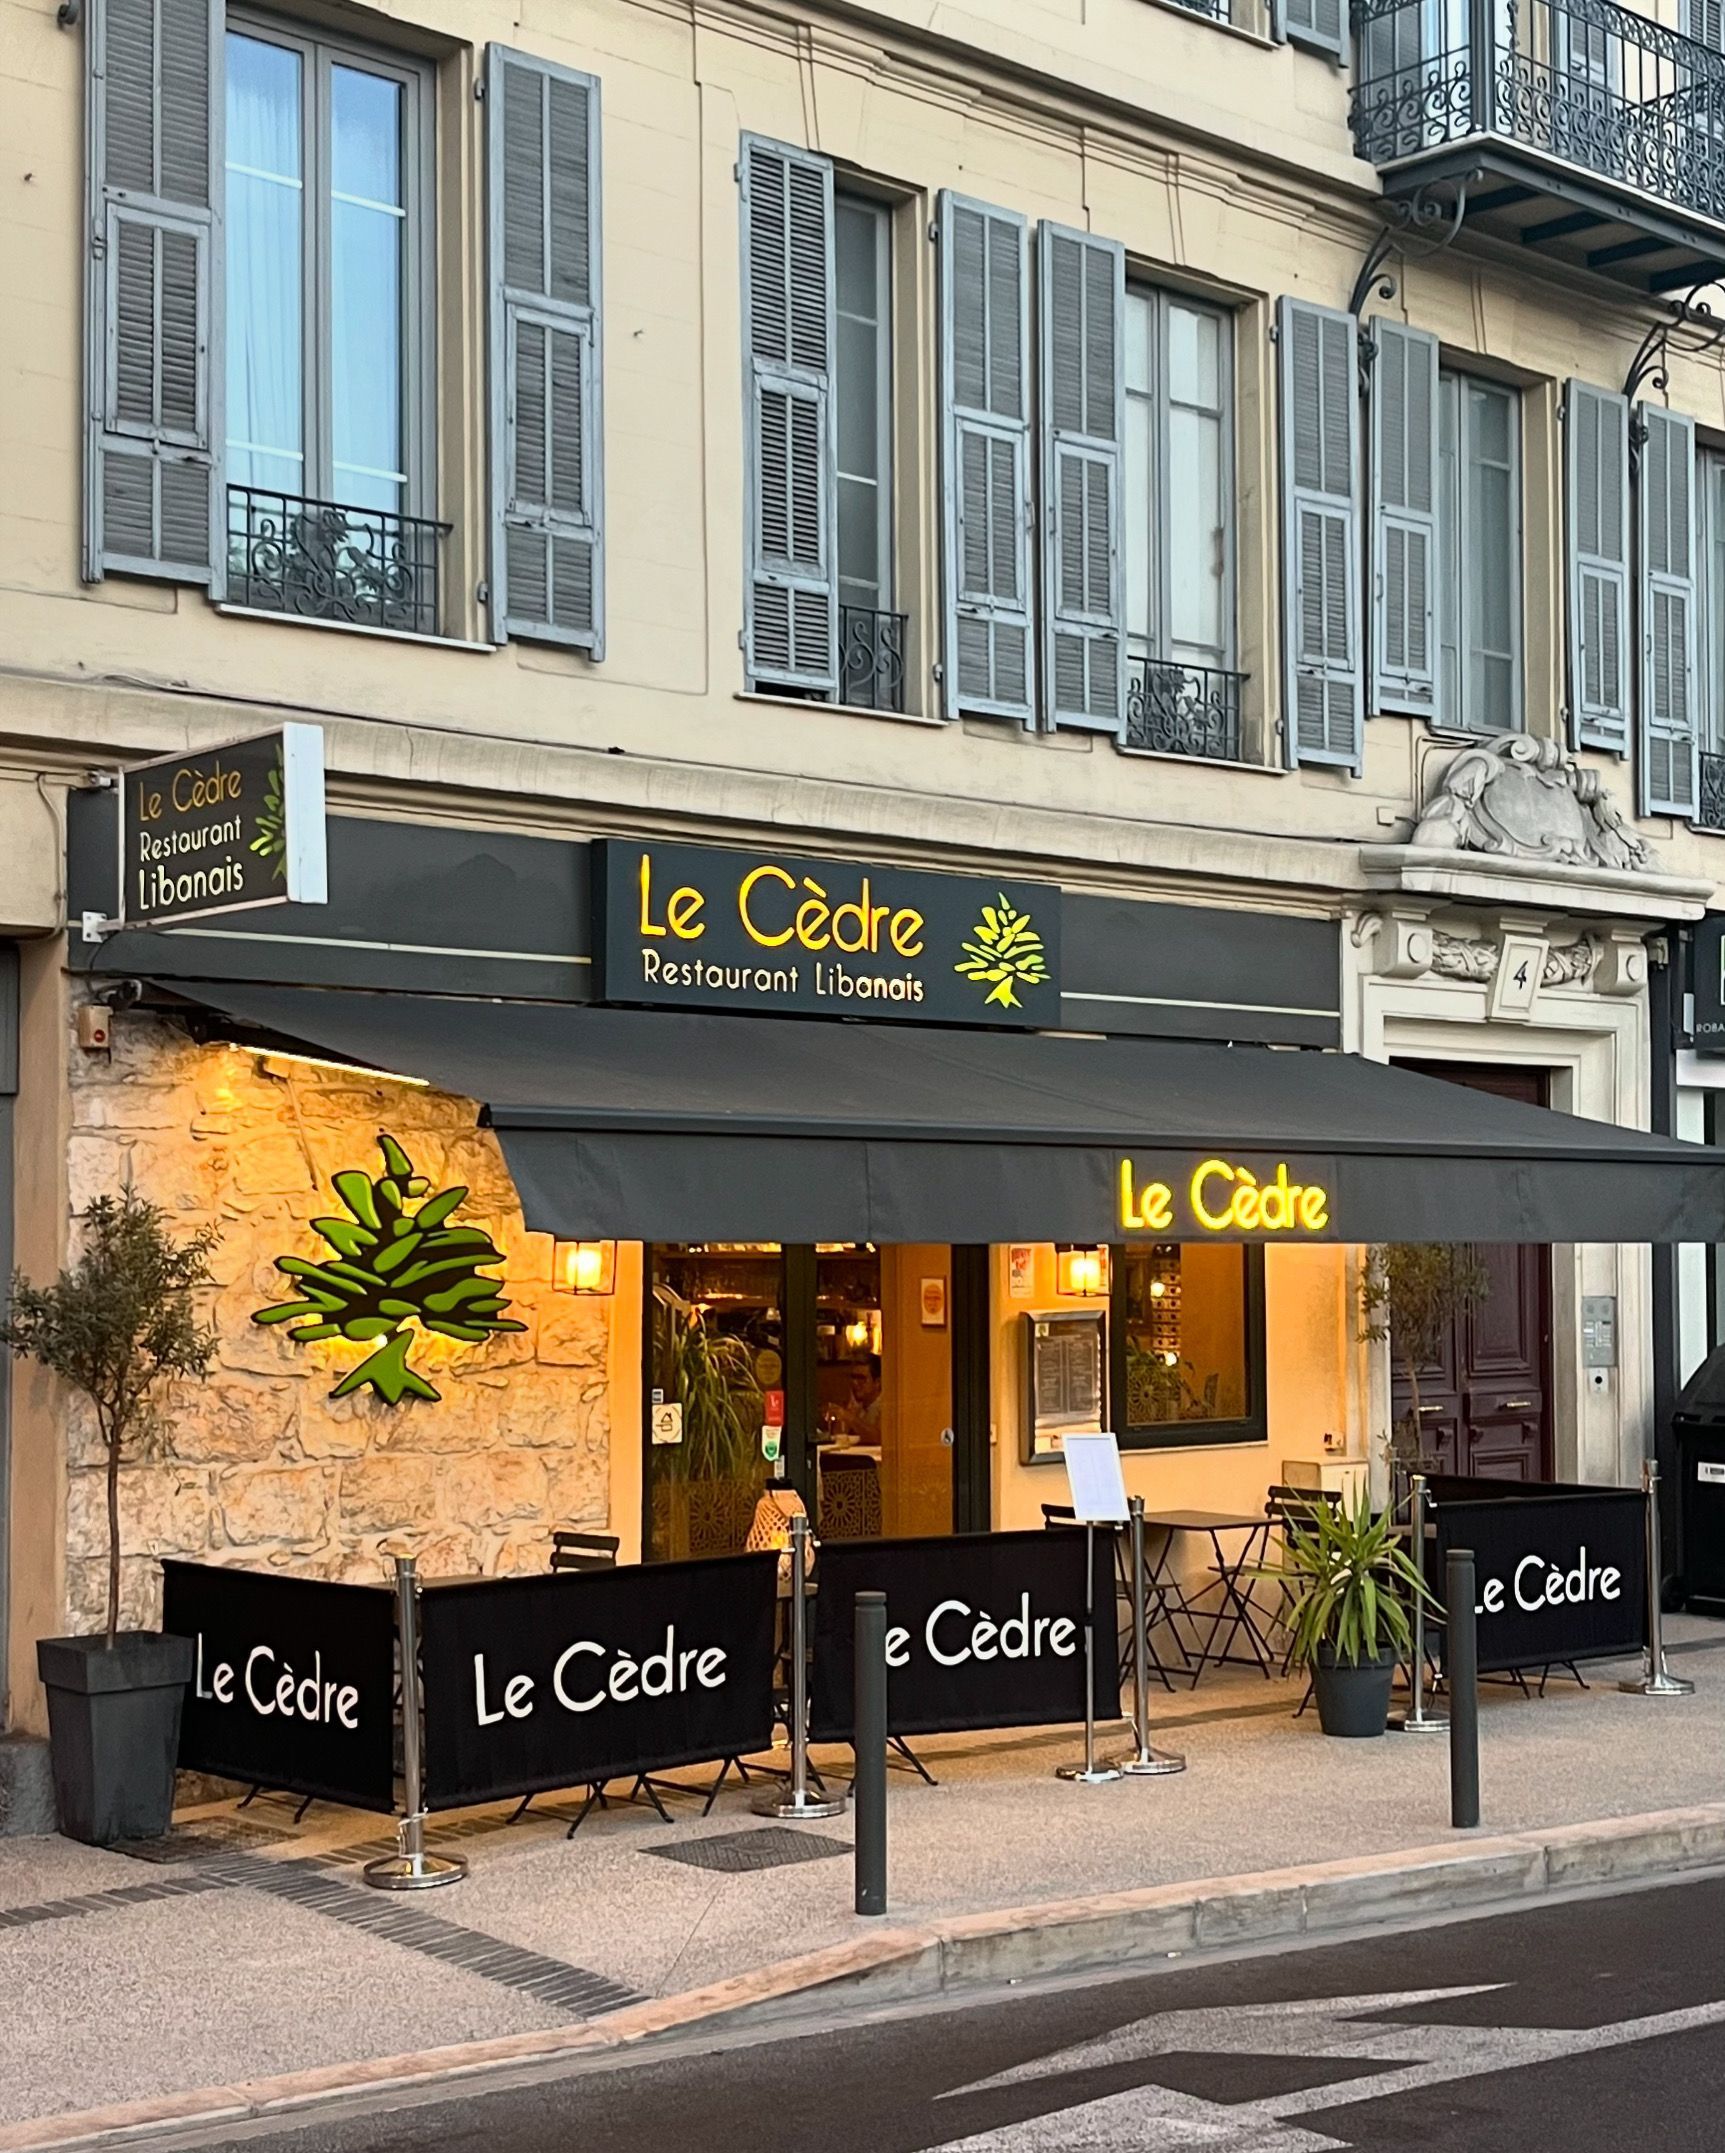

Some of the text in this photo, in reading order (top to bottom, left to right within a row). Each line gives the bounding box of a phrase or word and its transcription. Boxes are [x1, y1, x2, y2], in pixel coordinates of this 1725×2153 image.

[139, 760, 241, 821] Le Cèdre
[140, 814, 241, 862] Restaurant
[139, 855, 244, 910] Libanais
[639, 854, 924, 957] Le Cèdre
[642, 948, 925, 1003] Restaurant Libanais
[1513, 960, 1529, 990] 4
[1121, 1159, 1329, 1230] Le Cèdre
[1474, 1545, 1622, 1614] e Cèdre
[885, 1592, 1076, 1667] e Cèdre
[196, 1632, 359, 1729] Le Cèdre
[474, 1624, 727, 1726] Le Cèdre
